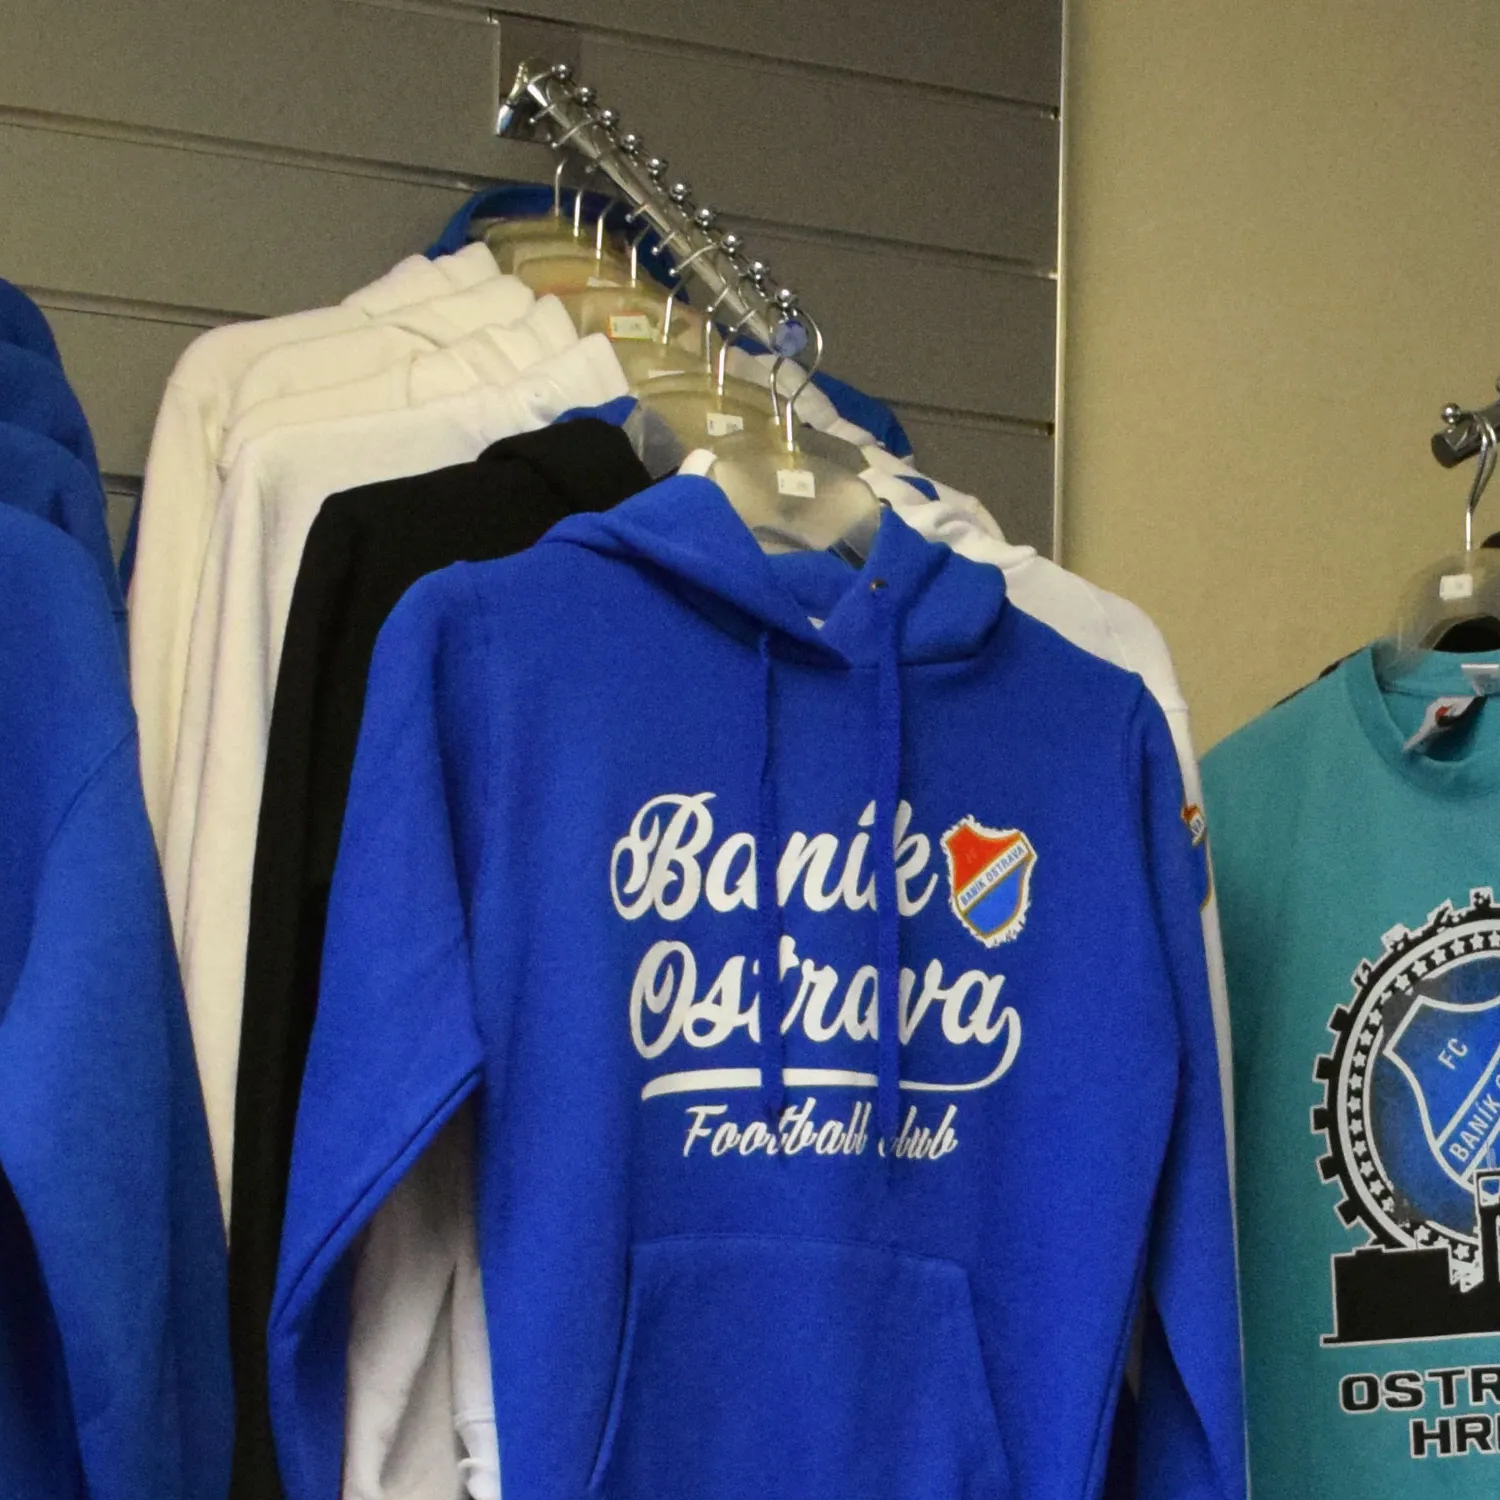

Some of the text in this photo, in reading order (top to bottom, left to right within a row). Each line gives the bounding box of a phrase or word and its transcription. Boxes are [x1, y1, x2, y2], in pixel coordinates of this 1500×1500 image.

[610, 791, 940, 922] Baník
[986, 845, 1026, 882] OSTRAVA
[628, 934, 1022, 1060] Ostrava
[1437, 1037, 1470, 1070] FC
[683, 1097, 871, 1158] Football
[1448, 1093, 1500, 1164] BANÍK
